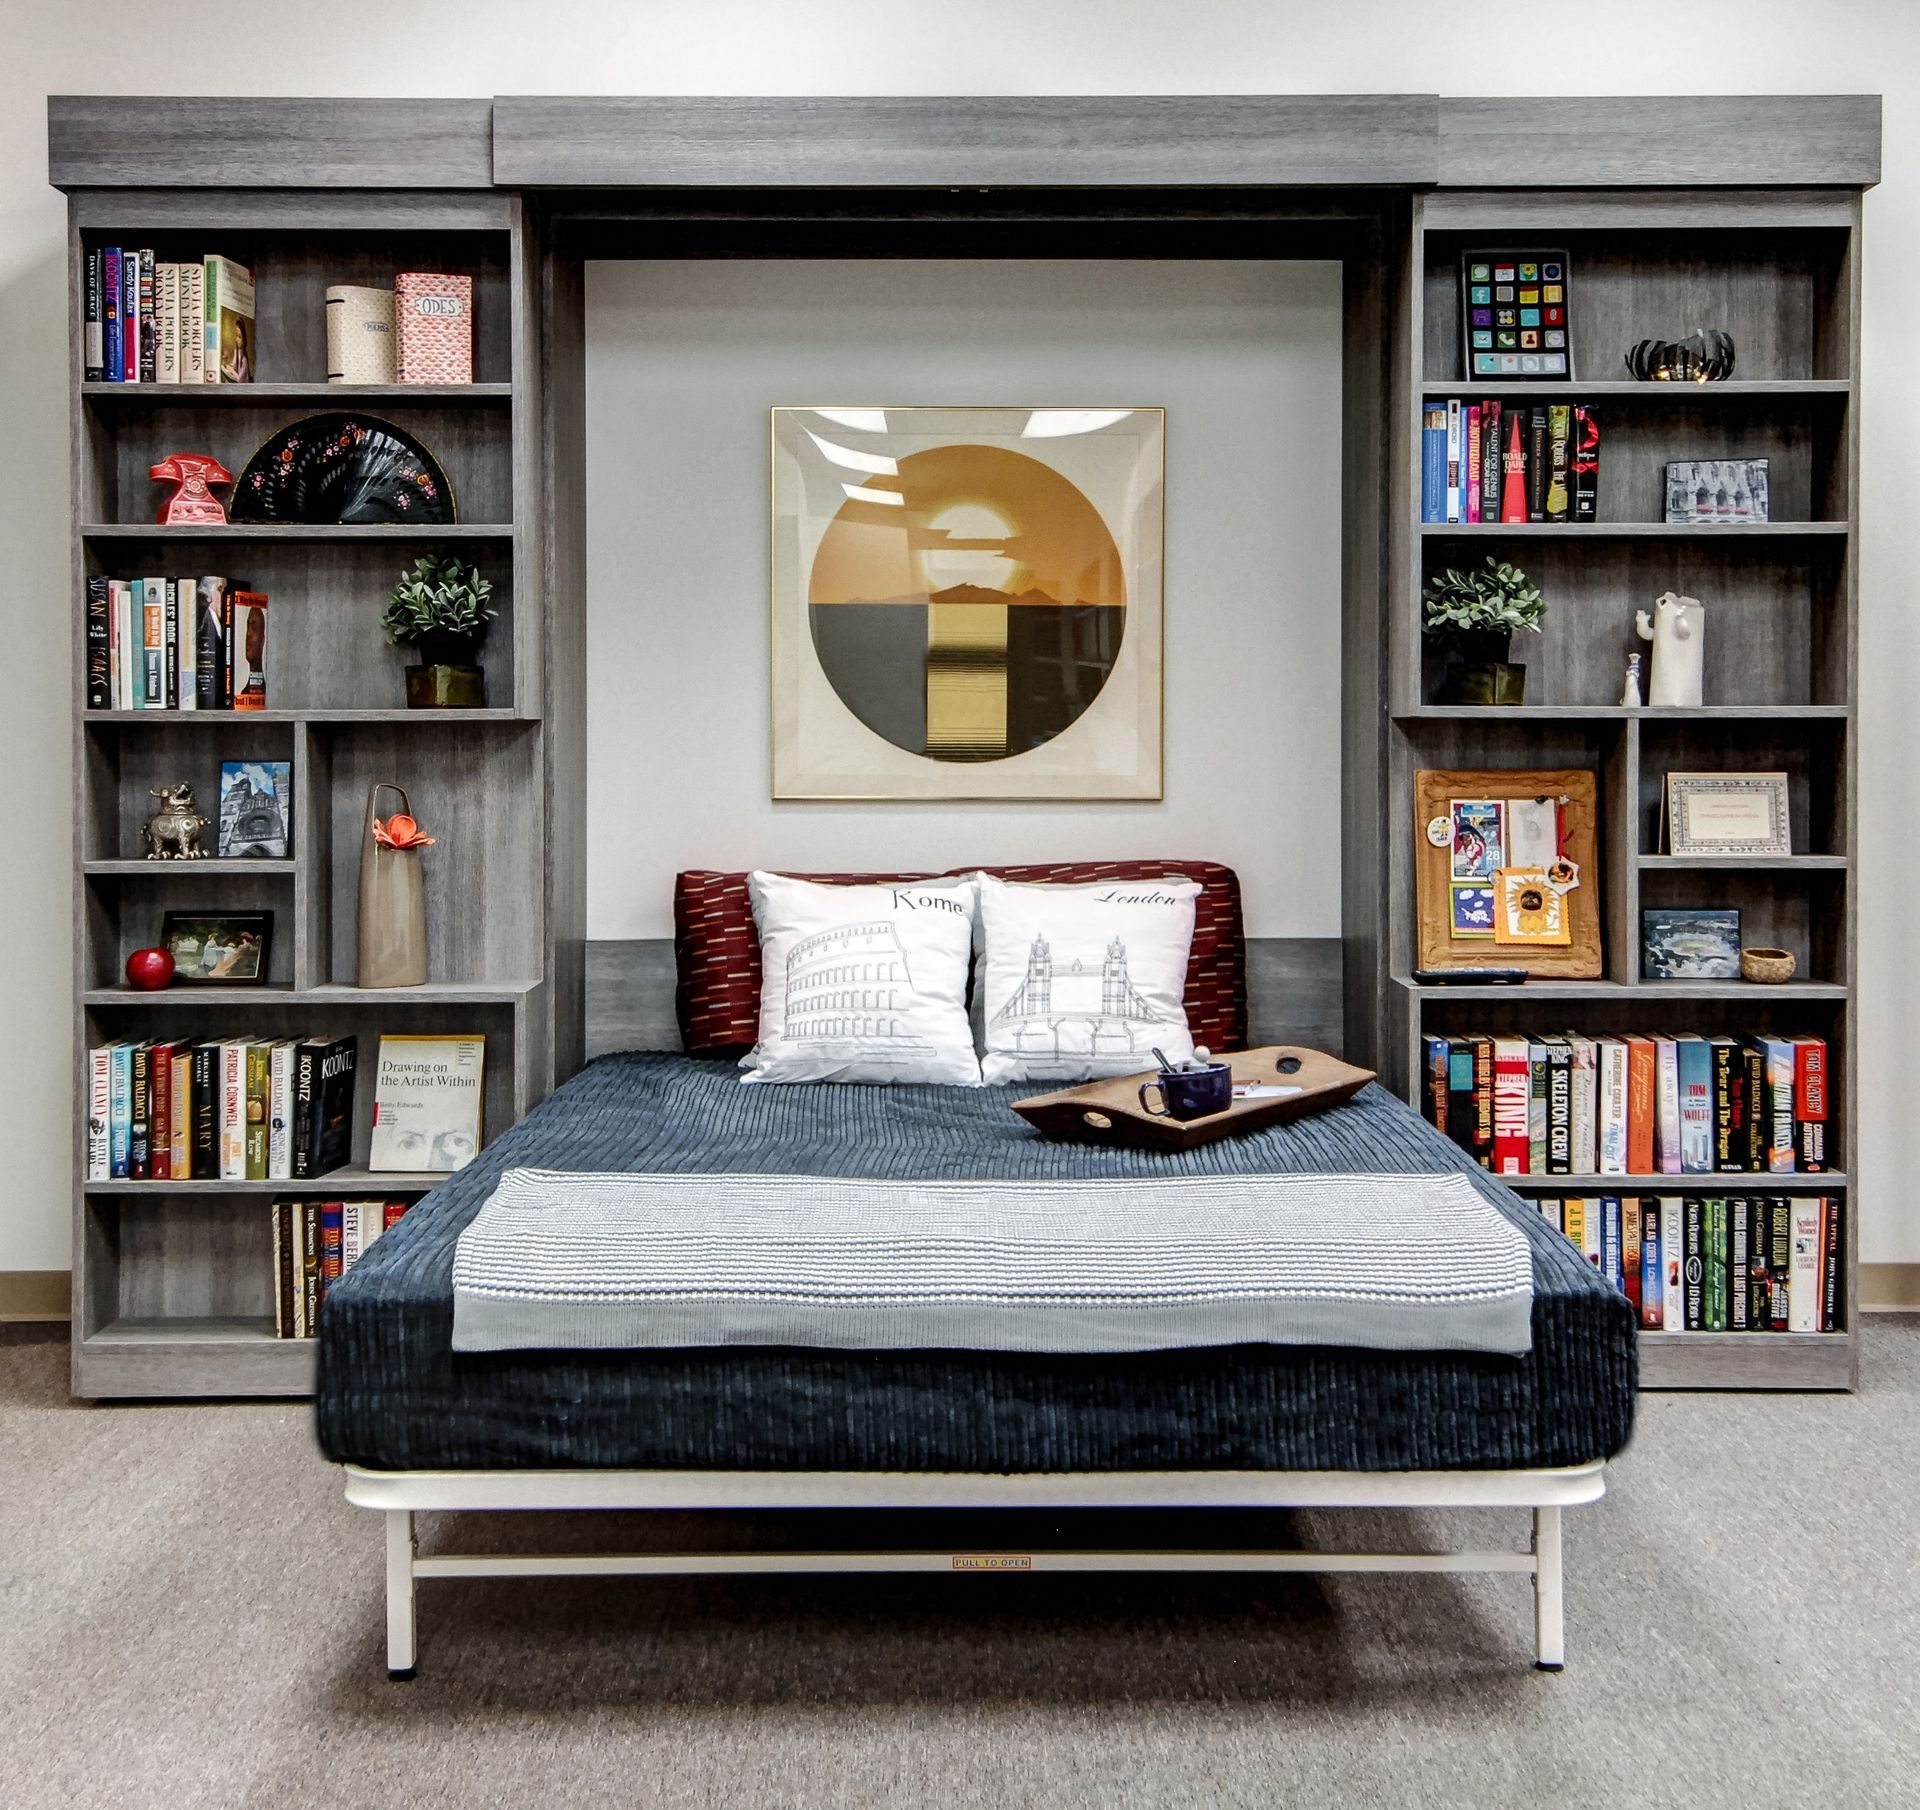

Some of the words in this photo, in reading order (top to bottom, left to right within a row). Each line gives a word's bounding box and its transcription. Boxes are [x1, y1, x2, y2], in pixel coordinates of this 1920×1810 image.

[90, 278, 95, 287] OF
[106, 258, 118, 302] KOONTZ
[126, 261, 135, 285] Sandy
[127, 287, 135, 313] Koufax
[155, 270, 163, 311] MONEY
[165, 269, 174, 311] SYLVIA
[181, 269, 190, 310] MONEY
[192, 269, 201, 310] SYLVIA
[422, 298, 456, 314] ODES
[155, 317, 163, 349] BOOK
[165, 316, 175, 371] PORTER'S
[182, 316, 190, 349] BOOK
[192, 316, 202, 371] PORTER'S
[1551, 440, 1565, 465] ROBERTS
[1577, 452, 1595, 461] eclipse
[89, 577, 108, 617] SUSAN
[167, 583, 175, 618] RICKLES'
[167, 621, 175, 643] BOOK
[91, 647, 108, 686] ISAACS
[149, 653, 157, 669] Thomas
[1486, 850, 1500, 860] 28
[1093, 890, 1176, 906] London
[95, 1055, 107, 1075] TOM
[115, 1052, 125, 1076] DAVID
[135, 1053, 146, 1078] DAVID
[227, 1049, 238, 1083] PATRICIA
[256, 1060, 264, 1080] JOHN
[274, 1051, 283, 1075] DAVID
[322, 1050, 355, 1079] KOONTZ
[382, 1061, 430, 1074] Drawing
[433, 1064, 447, 1072] on
[1612, 1049, 1622, 1087] CATHERINE
[1719, 1049, 1729, 1065] The
[1752, 1058, 1760, 1078] DAVID
[1806, 1050, 1820, 1071] TOM
[298, 1058, 312, 1102] KOONTZ
[381, 1076, 398, 1086] the
[401, 1076, 433, 1086] Artist
[437, 1076, 475, 1087] Within
[1663, 1077, 1674, 1105] away
[1688, 1085, 1706, 1096] TOM
[1719, 1067, 1729, 1088] Bear
[95, 1080, 107, 1116] CLANCY
[115, 1078, 125, 1116] BALDACCI
[135, 1080, 146, 1119] BALDACCI
[226, 1087, 238, 1128] CORNWELL
[274, 1078, 284, 1116] BALDACCI
[397, 1101, 423, 1109] Edwards
[1551, 1069, 1568, 1125] SKELETON
[1719, 1091, 1730, 1107] and
[1752, 1080, 1761, 1111] BALDACCI
[1806, 1074, 1821, 1114] CLANCY
[1495, 1083, 1527, 1137] KING
[1684, 1109, 1710, 1121] WOLFE
[1719, 1109, 1730, 1125] The
[199, 1105, 212, 1151] MARY
[1774, 1112, 1792, 1153] FRANZEN
[98, 1138, 107, 1165] BATTLE
[1551, 1127, 1568, 1161] CREW
[1719, 1128, 1731, 1159] Dragon
[1803, 1122, 1814, 1162] AUTHORITY
[1814, 1124, 1823, 1160] COMMAND
[347, 1208, 358, 1237] STEVE
[1570, 1208, 1581, 1216] J.
[1570, 1220, 1581, 1228] D.
[1627, 1211, 1637, 1231] JAMES
[1688, 1204, 1698, 1225] NORA
[1734, 1202, 1746, 1229] PATRICIA
[1755, 1201, 1763, 1220] JOHN
[1773, 1208, 1787, 1235] ROBERT
[329, 1229, 338, 1251] TOM
[1646, 1213, 1656, 1240] HARLAN
[1667, 1212, 1679, 1258] KOONTZ
[1627, 1231, 1637, 1266] PATTERSON
[1646, 1242, 1657, 1264] COBEN
[1773, 1237, 1788, 1266] LUDLUM
[1734, 1265, 1746, 1276] THE
[308, 1277, 316, 1294] JOHN
[1734, 1277, 1746, 1292] LAST
[1827, 1278, 1835, 1313] GRISHAM
[1734, 1293, 1746, 1323] PRECINCT
[1771, 1283, 1780, 1318] DIRECTIVE
